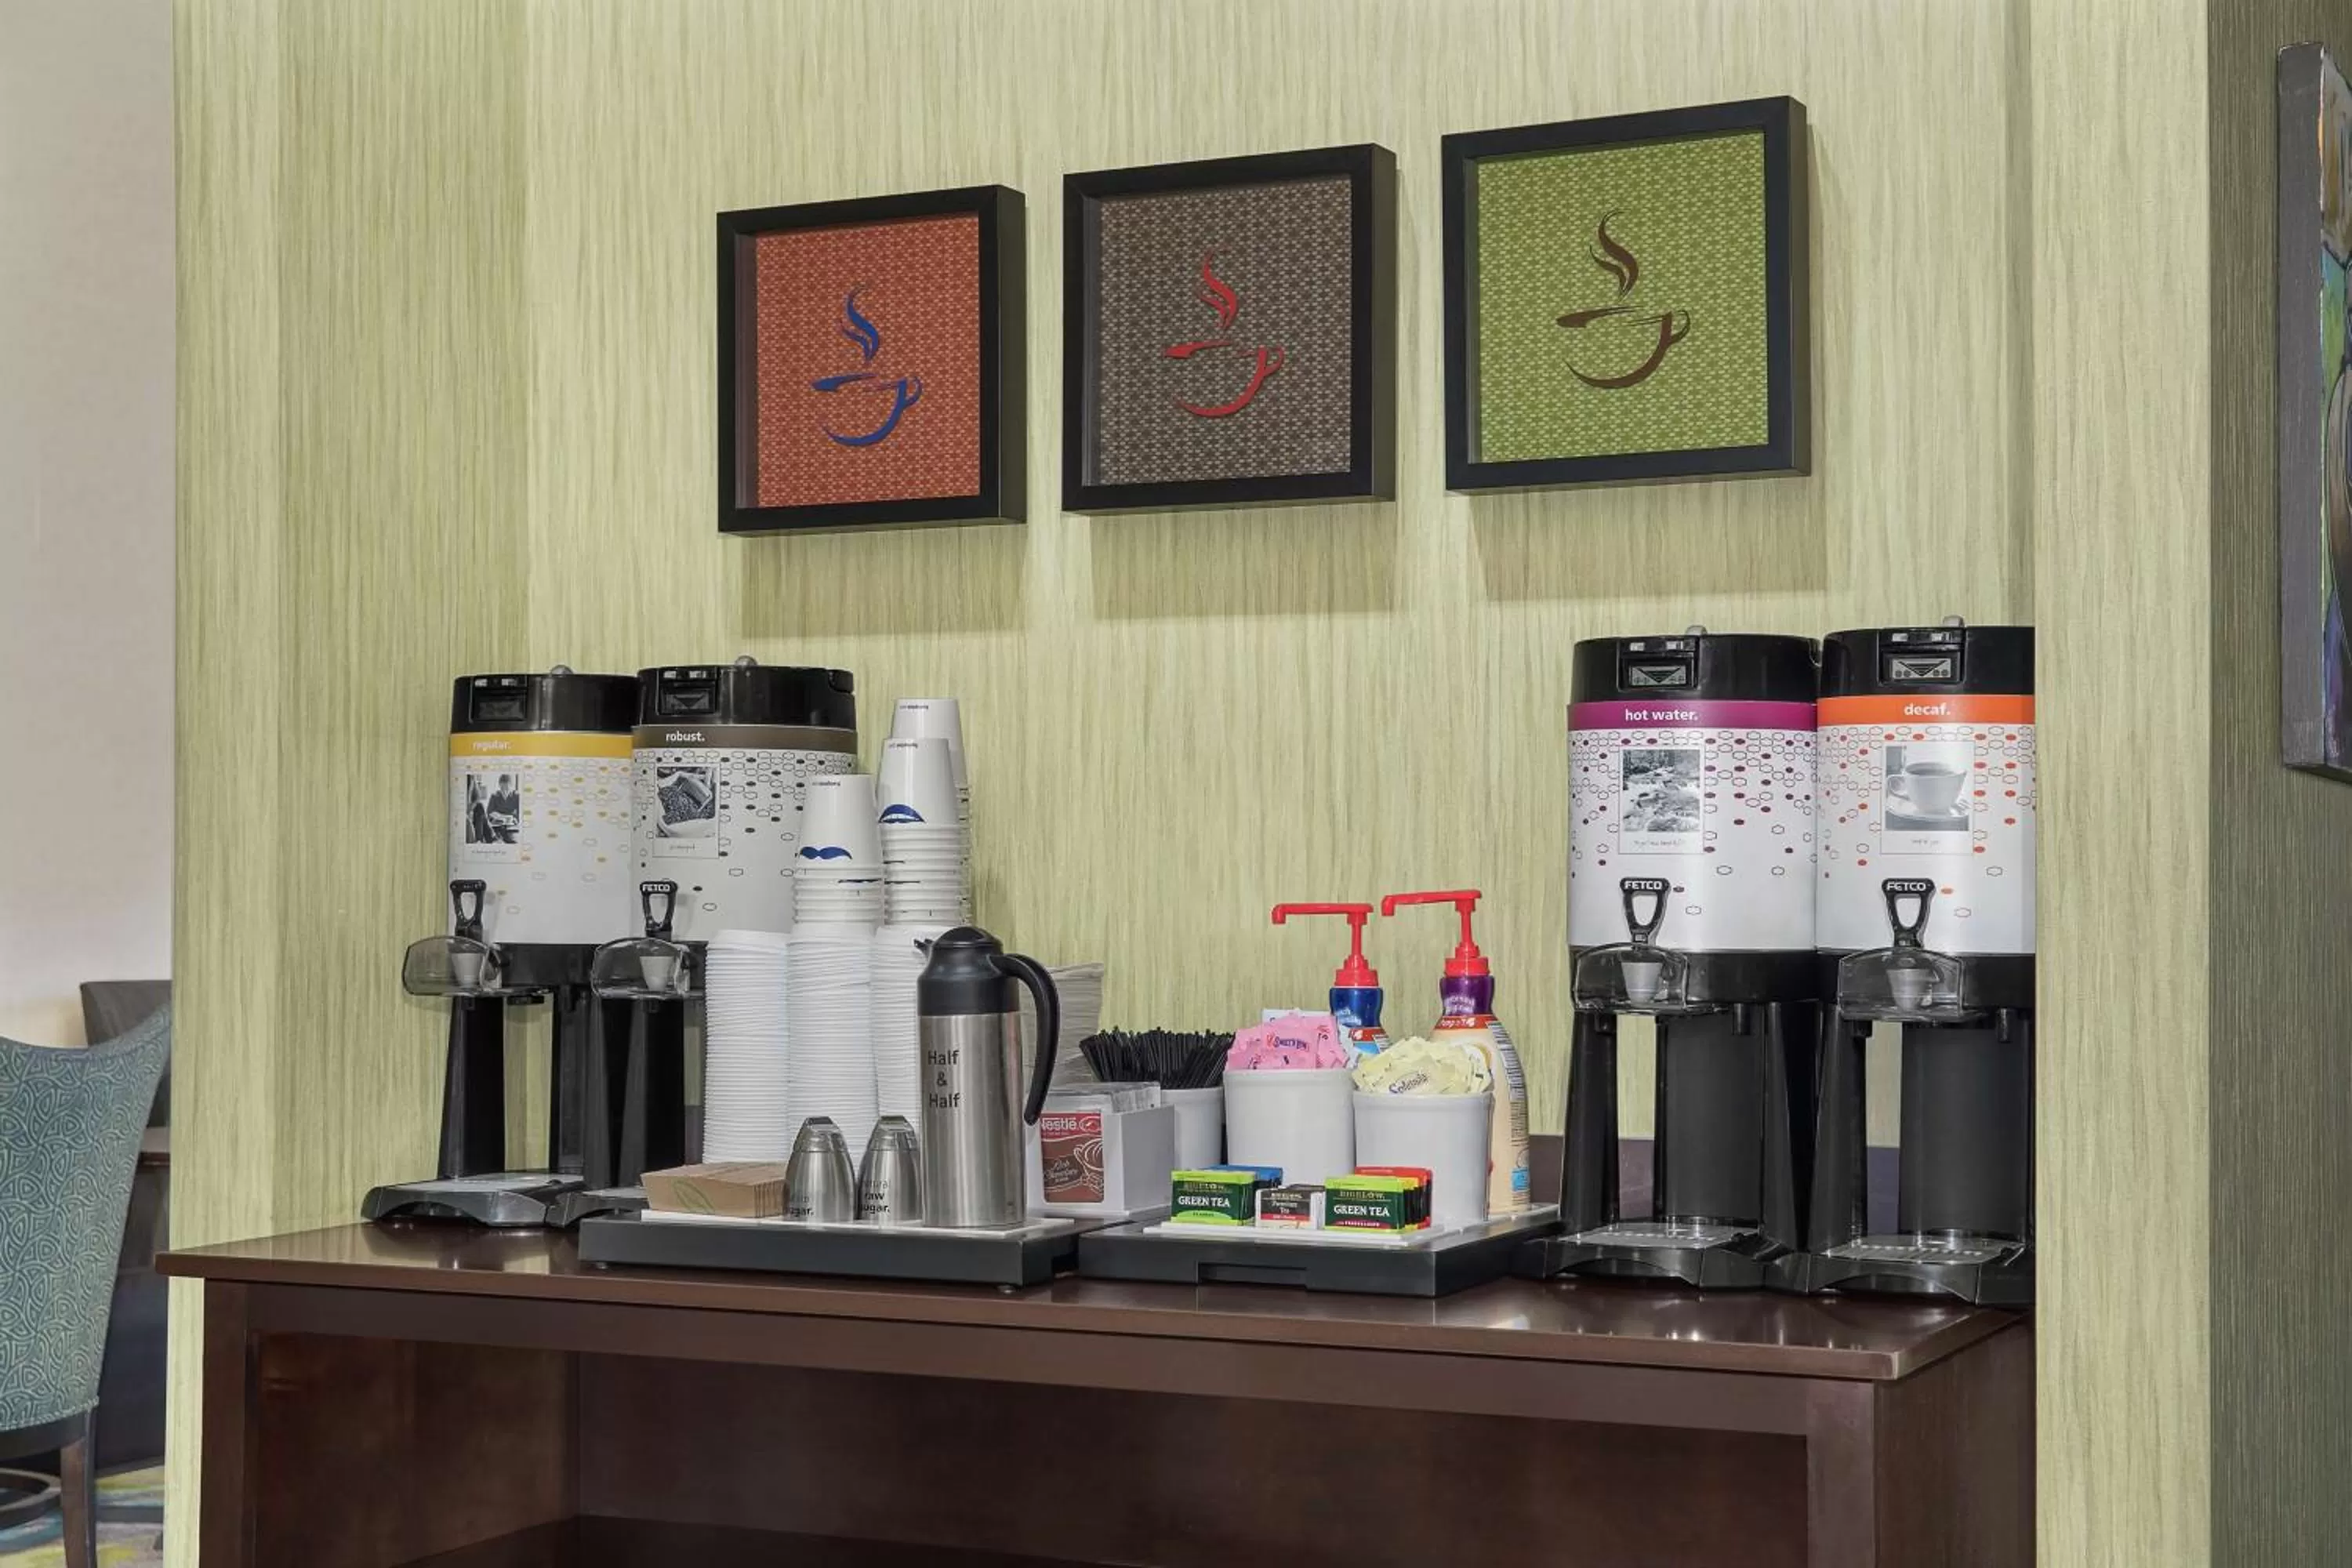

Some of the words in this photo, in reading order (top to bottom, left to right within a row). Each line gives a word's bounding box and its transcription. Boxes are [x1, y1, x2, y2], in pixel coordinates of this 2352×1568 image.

[1624, 709, 1649, 721] hot
[1652, 710, 1698, 721] water.
[1904, 702, 1951, 716] decaf.
[666, 731, 705, 742] robust.
[473, 739, 512, 752] regular.
[642, 883, 671, 892] FETCO
[1624, 880, 1662, 891] FETCO
[1886, 881, 1926, 891] FETCO
[927, 1050, 960, 1065] Half
[937, 1072, 947, 1086] &
[929, 1092, 960, 1108] Half
[1178, 1196, 1209, 1207] GREEN
[1210, 1197, 1230, 1208] TEA
[1334, 1204, 1367, 1216] GREEN
[1369, 1207, 1391, 1217] TEA
